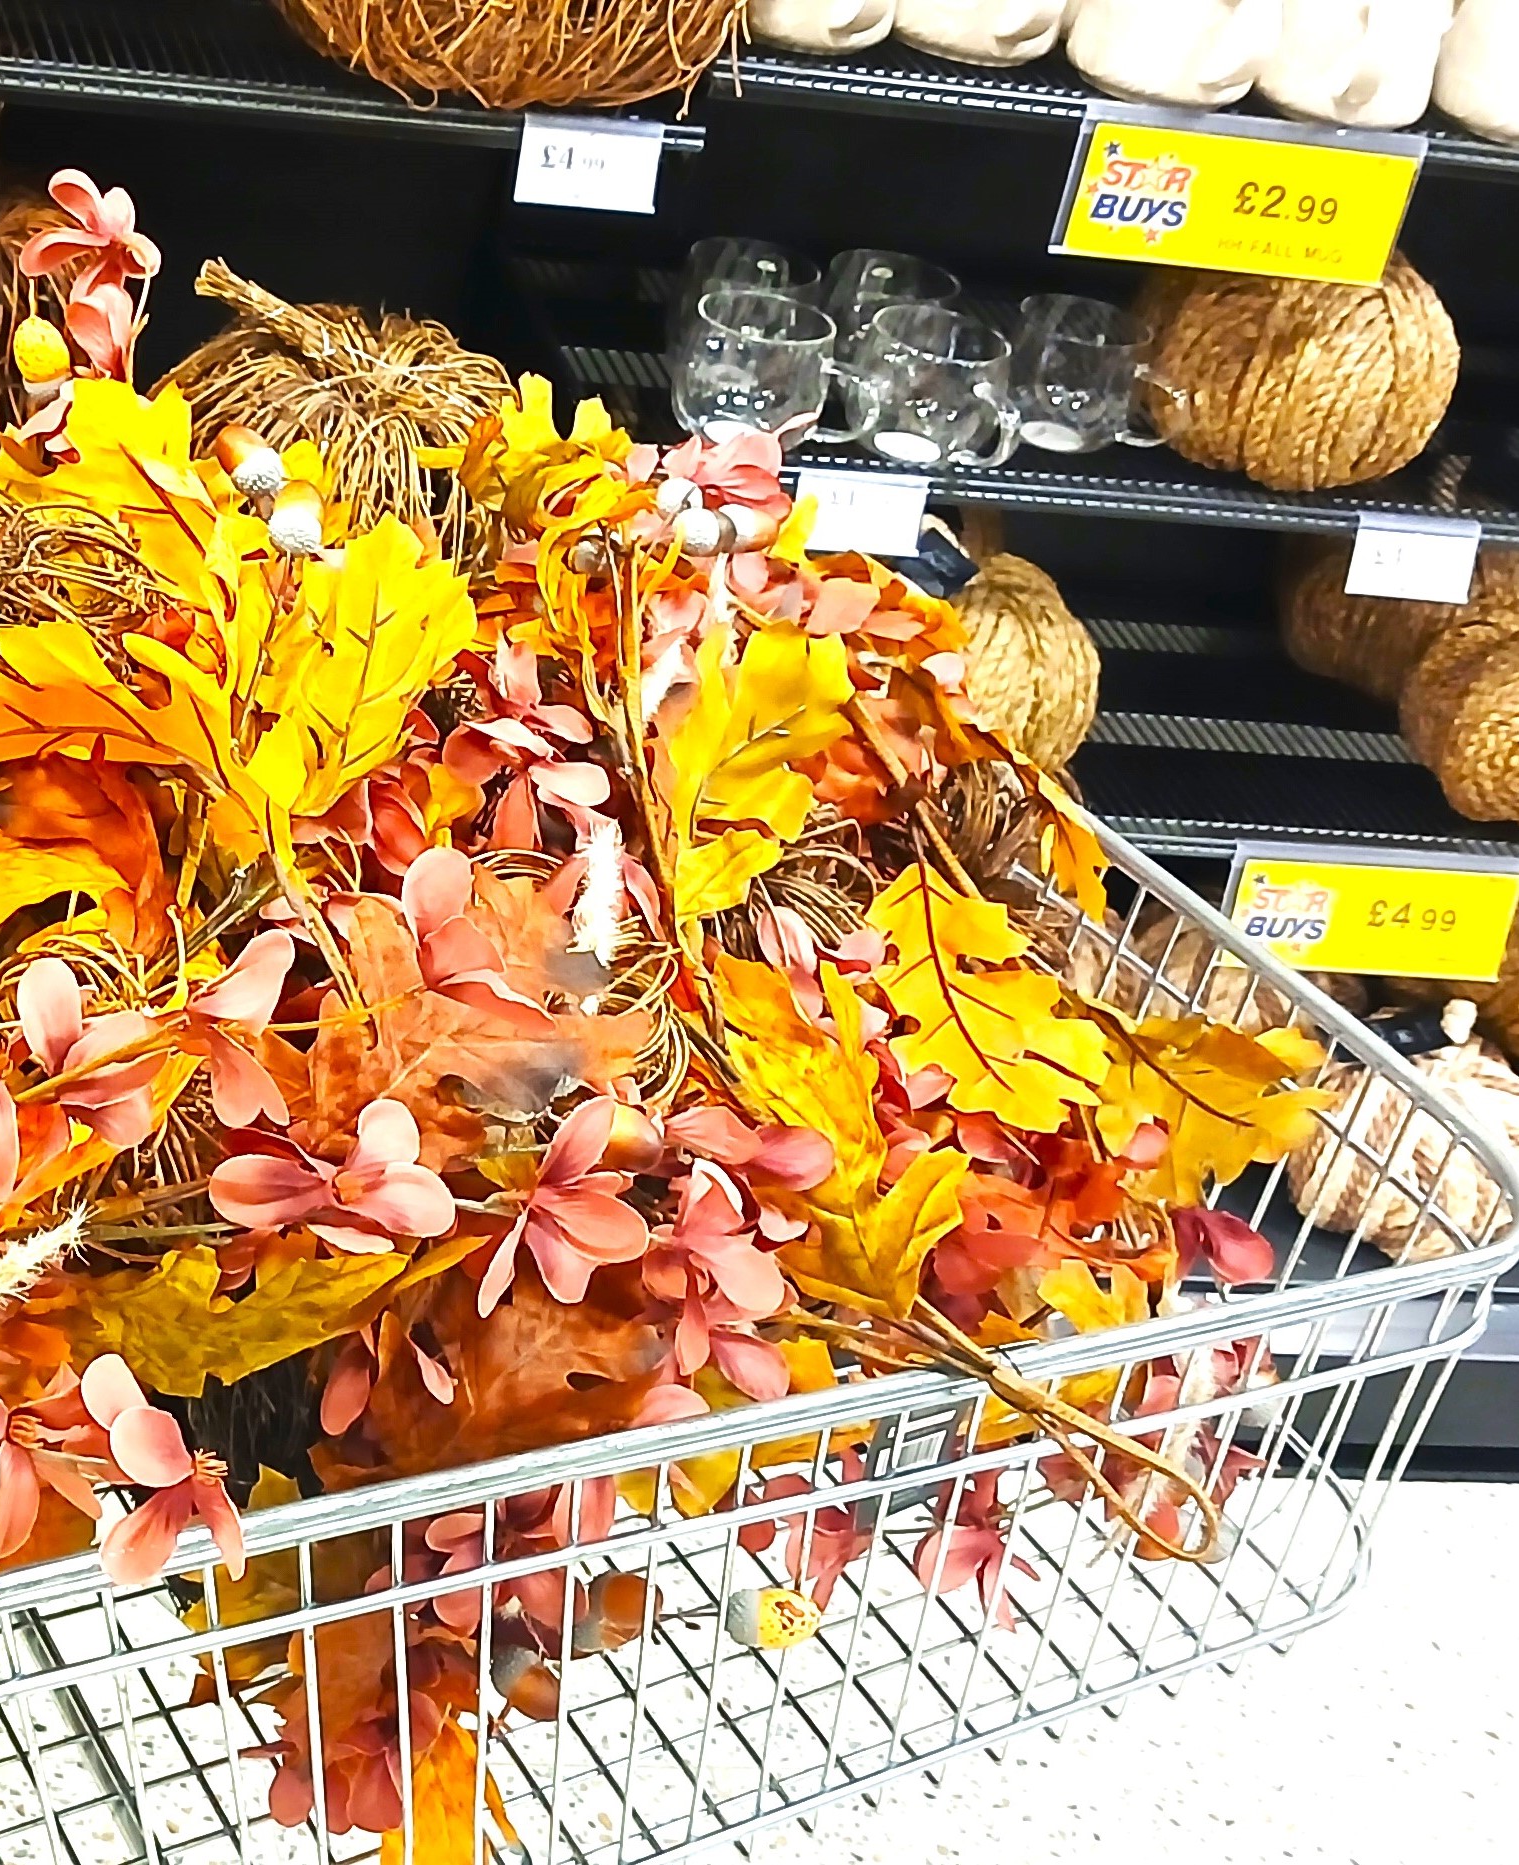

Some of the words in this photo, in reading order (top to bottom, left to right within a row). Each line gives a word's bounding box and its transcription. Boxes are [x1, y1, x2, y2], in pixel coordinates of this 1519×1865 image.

[540, 144, 605, 171] £499
[1090, 193, 1188, 227] BUYS
[1233, 181, 1339, 225] £2.99
[1252, 886, 1329, 914] STR
[1244, 915, 1327, 940] BUYS
[1366, 899, 1457, 933] £499
